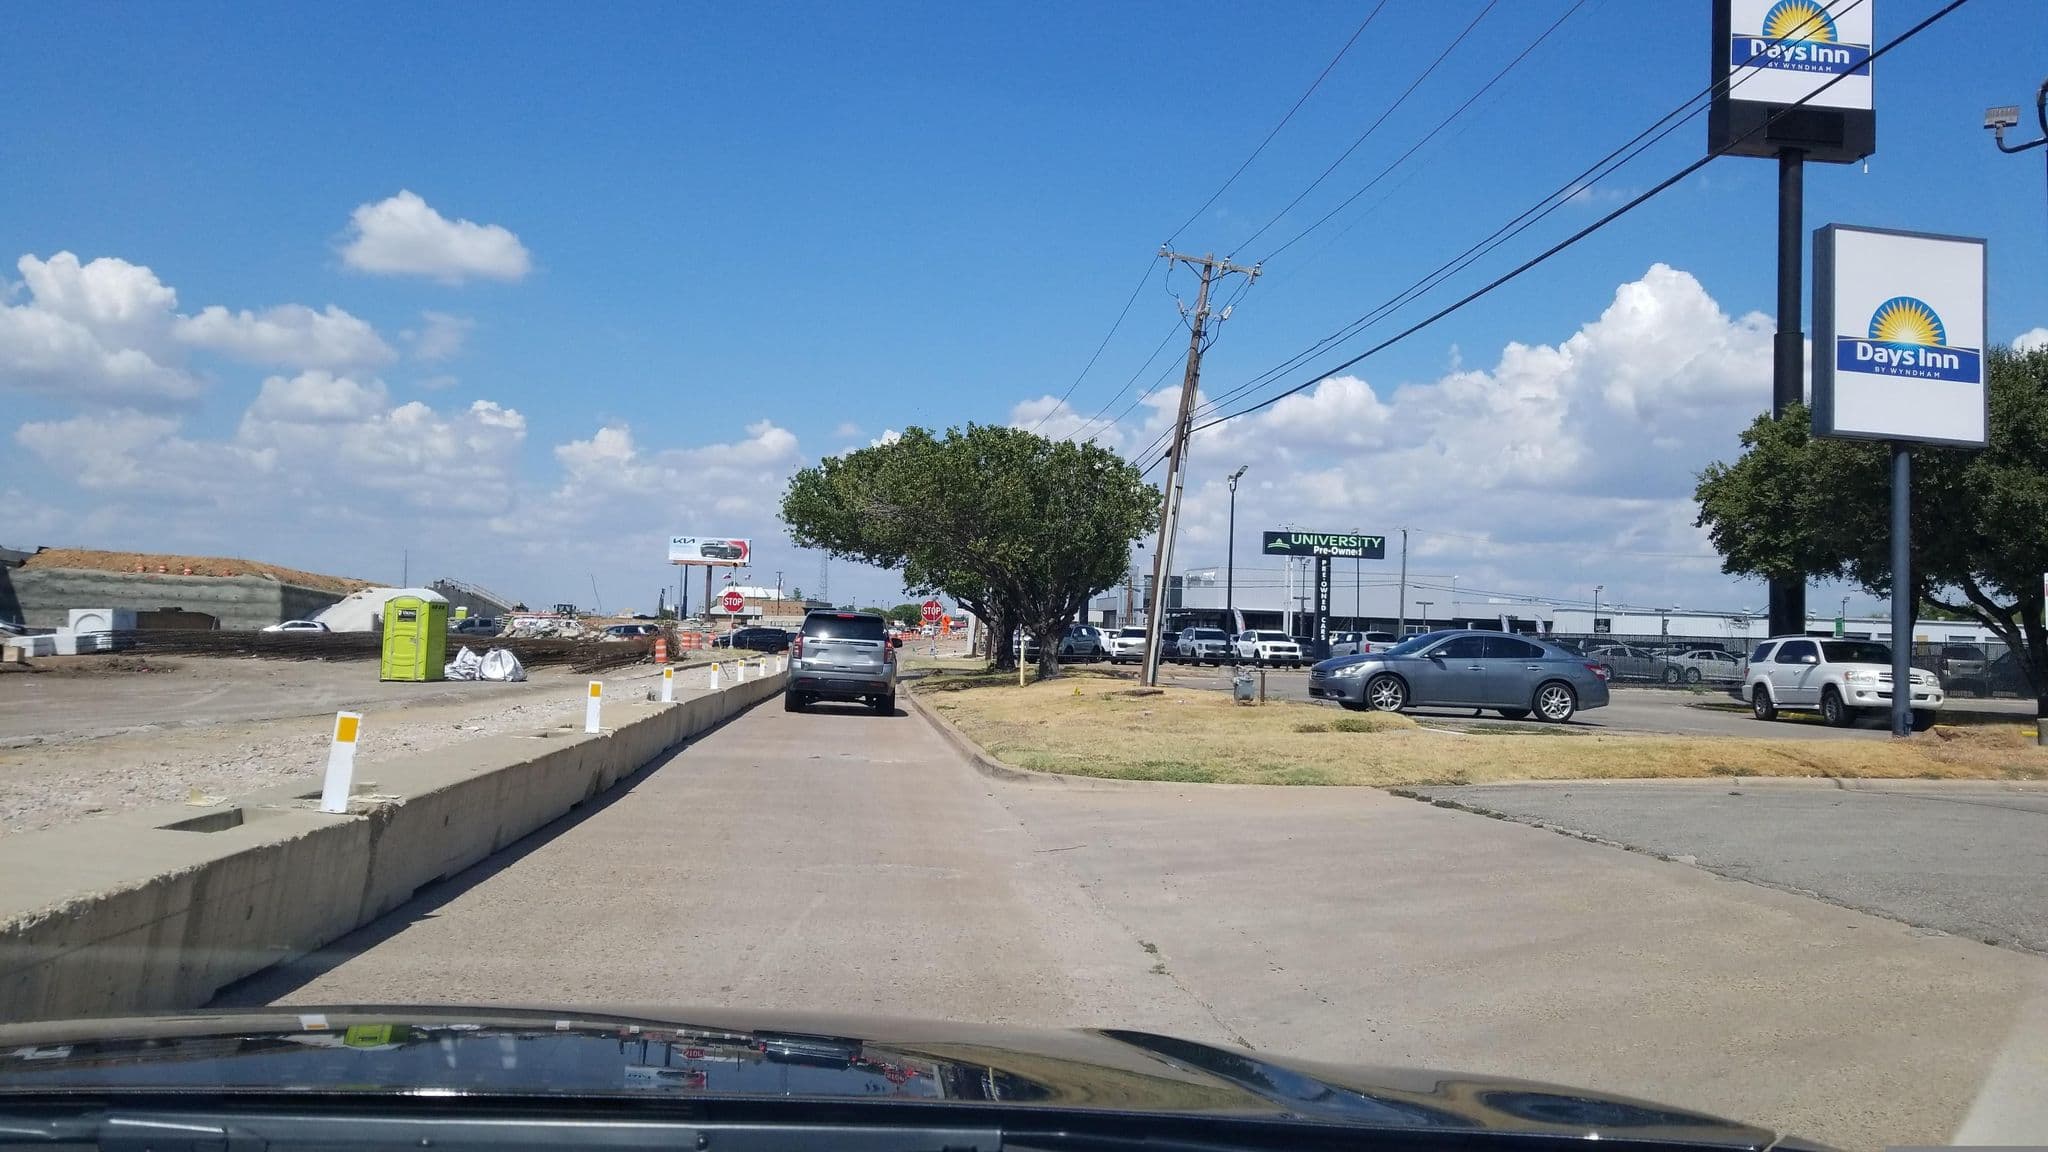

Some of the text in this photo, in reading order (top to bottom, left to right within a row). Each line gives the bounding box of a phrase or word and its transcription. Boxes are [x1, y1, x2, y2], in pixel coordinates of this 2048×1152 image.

[1750, 39, 1850, 65] Days Inn
[1783, 62, 1832, 72] WYNDHAM
[1856, 342, 1959, 370] Days Inn
[1874, 366, 1941, 378] BY WYNDHAM
[1291, 533, 1382, 548] UNIVERSITY
[1313, 545, 1363, 557] Pre-Owned
[724, 597, 742, 606] STOP
[922, 605, 942, 615] STOP
